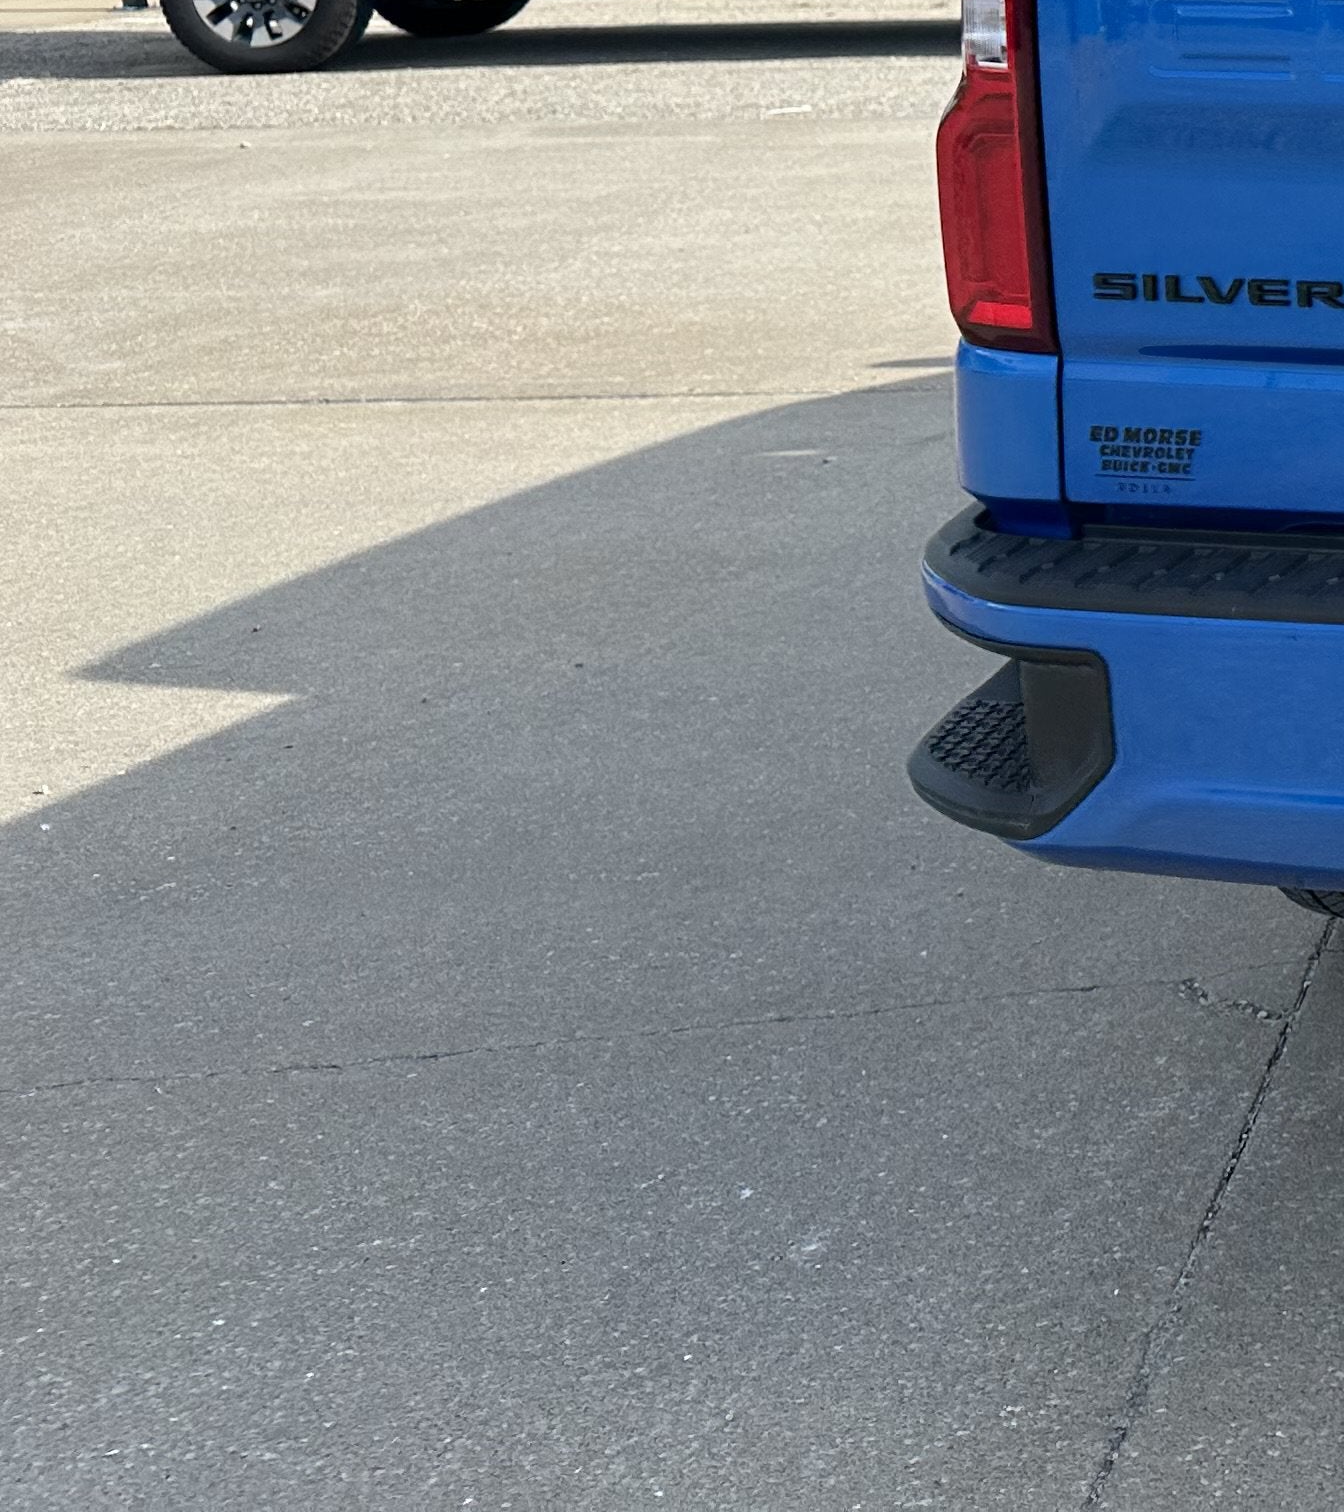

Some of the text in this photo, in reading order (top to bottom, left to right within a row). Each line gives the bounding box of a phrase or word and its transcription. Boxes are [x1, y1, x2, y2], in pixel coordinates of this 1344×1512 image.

[1089, 425, 1203, 446] ED MORSE
[1099, 444, 1196, 460] CHEVROLET
